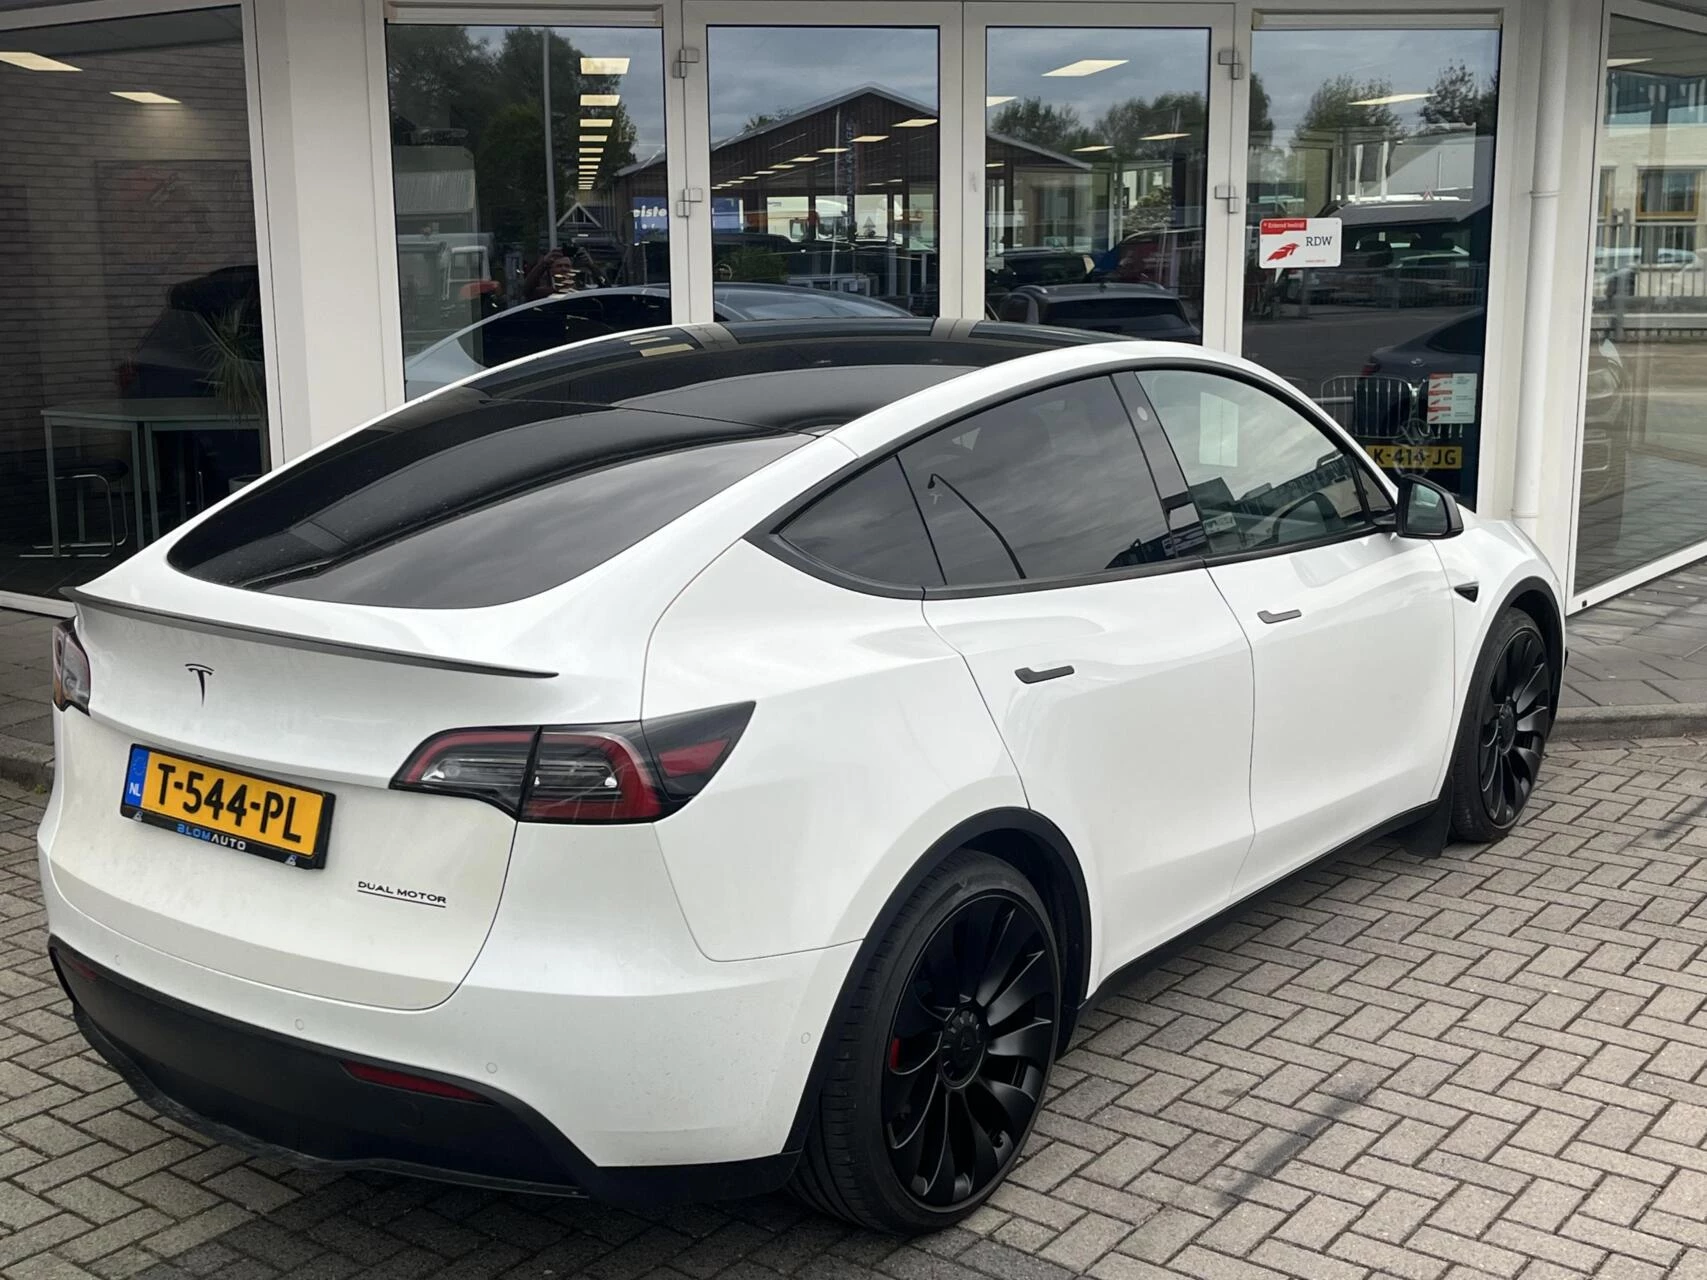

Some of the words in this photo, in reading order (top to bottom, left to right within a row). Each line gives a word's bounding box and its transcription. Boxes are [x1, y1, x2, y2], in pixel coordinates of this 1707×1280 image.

[1305, 236, 1333, 247] RDW
[128, 782, 141, 798] NL
[157, 762, 302, 844] T-544-PL
[357, 880, 394, 895] DUAL
[396, 888, 447, 904] MOTOR
